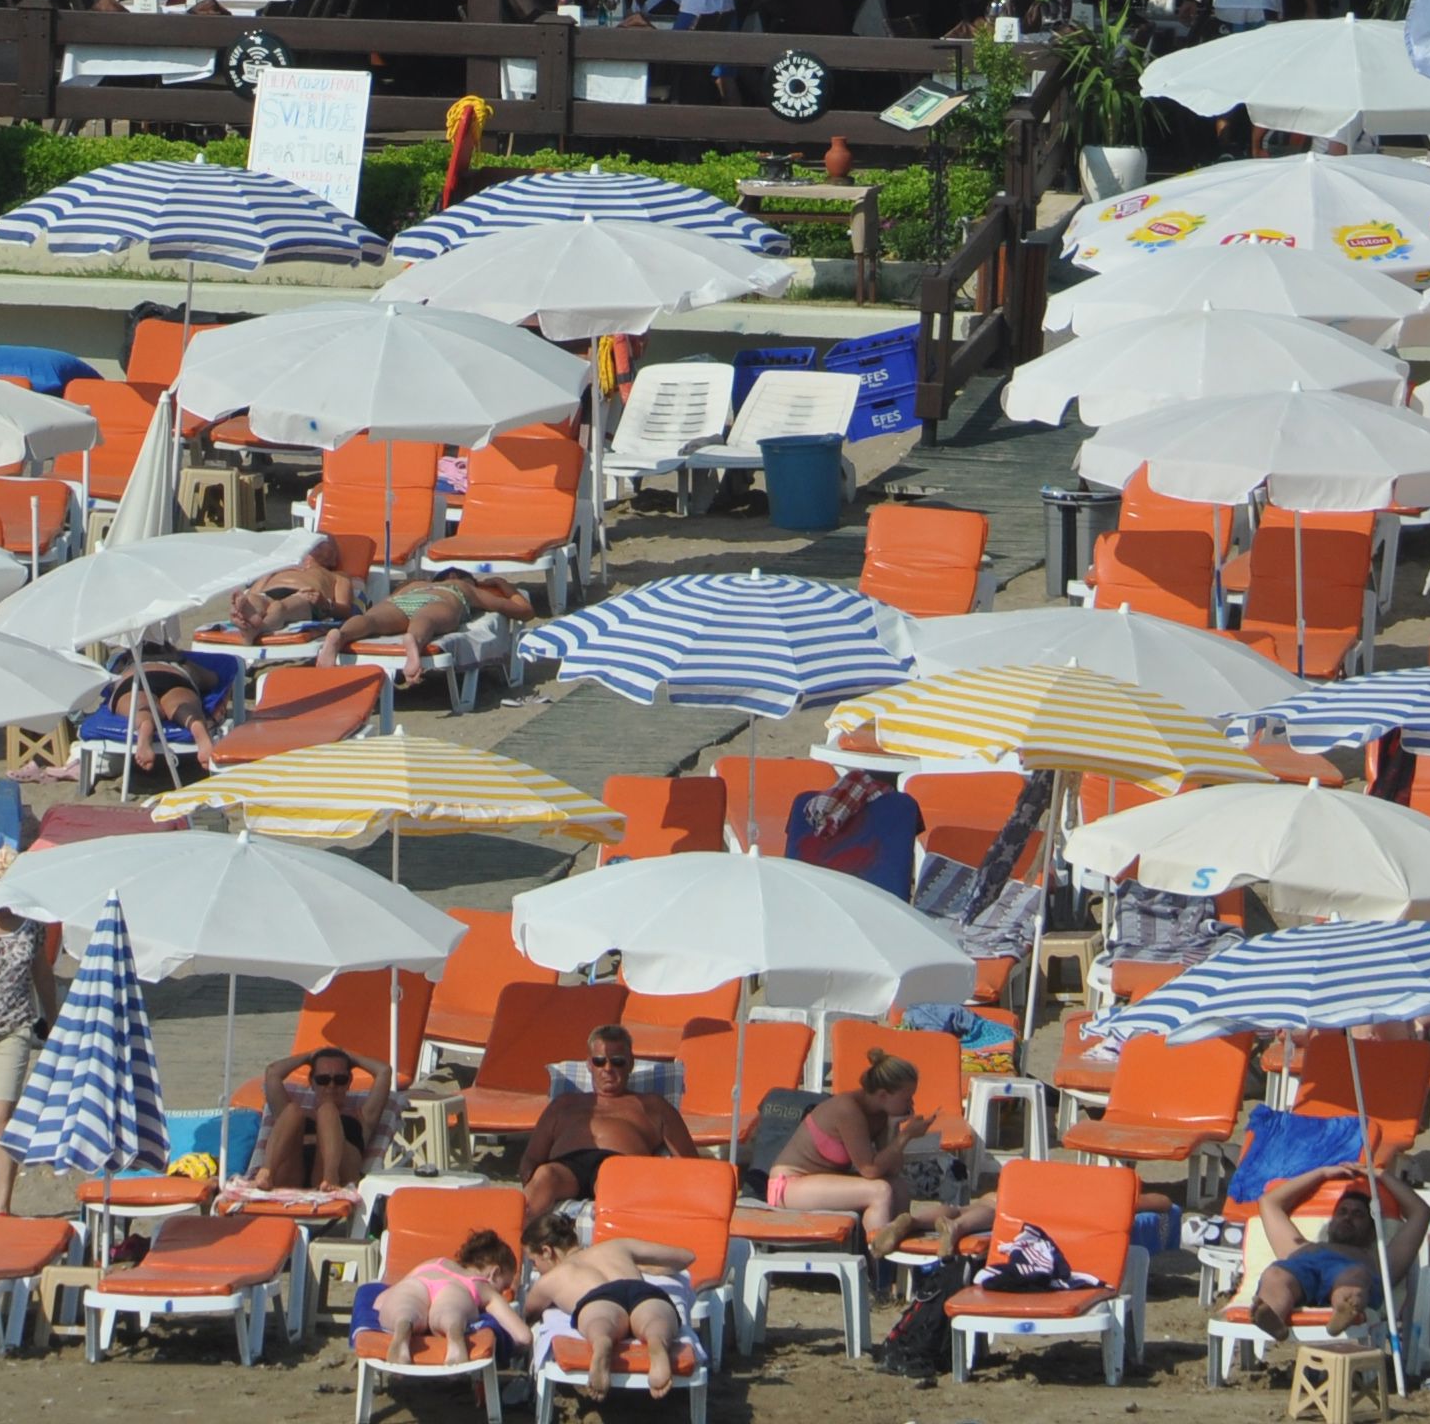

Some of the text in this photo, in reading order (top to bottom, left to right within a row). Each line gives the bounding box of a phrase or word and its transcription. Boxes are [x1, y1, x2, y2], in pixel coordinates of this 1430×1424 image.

[261, 98, 357, 132] SVERIGE
[1350, 236, 1388, 247] Lipton
[860, 368, 889, 385] EFES
[871, 409, 902, 428] EFES
